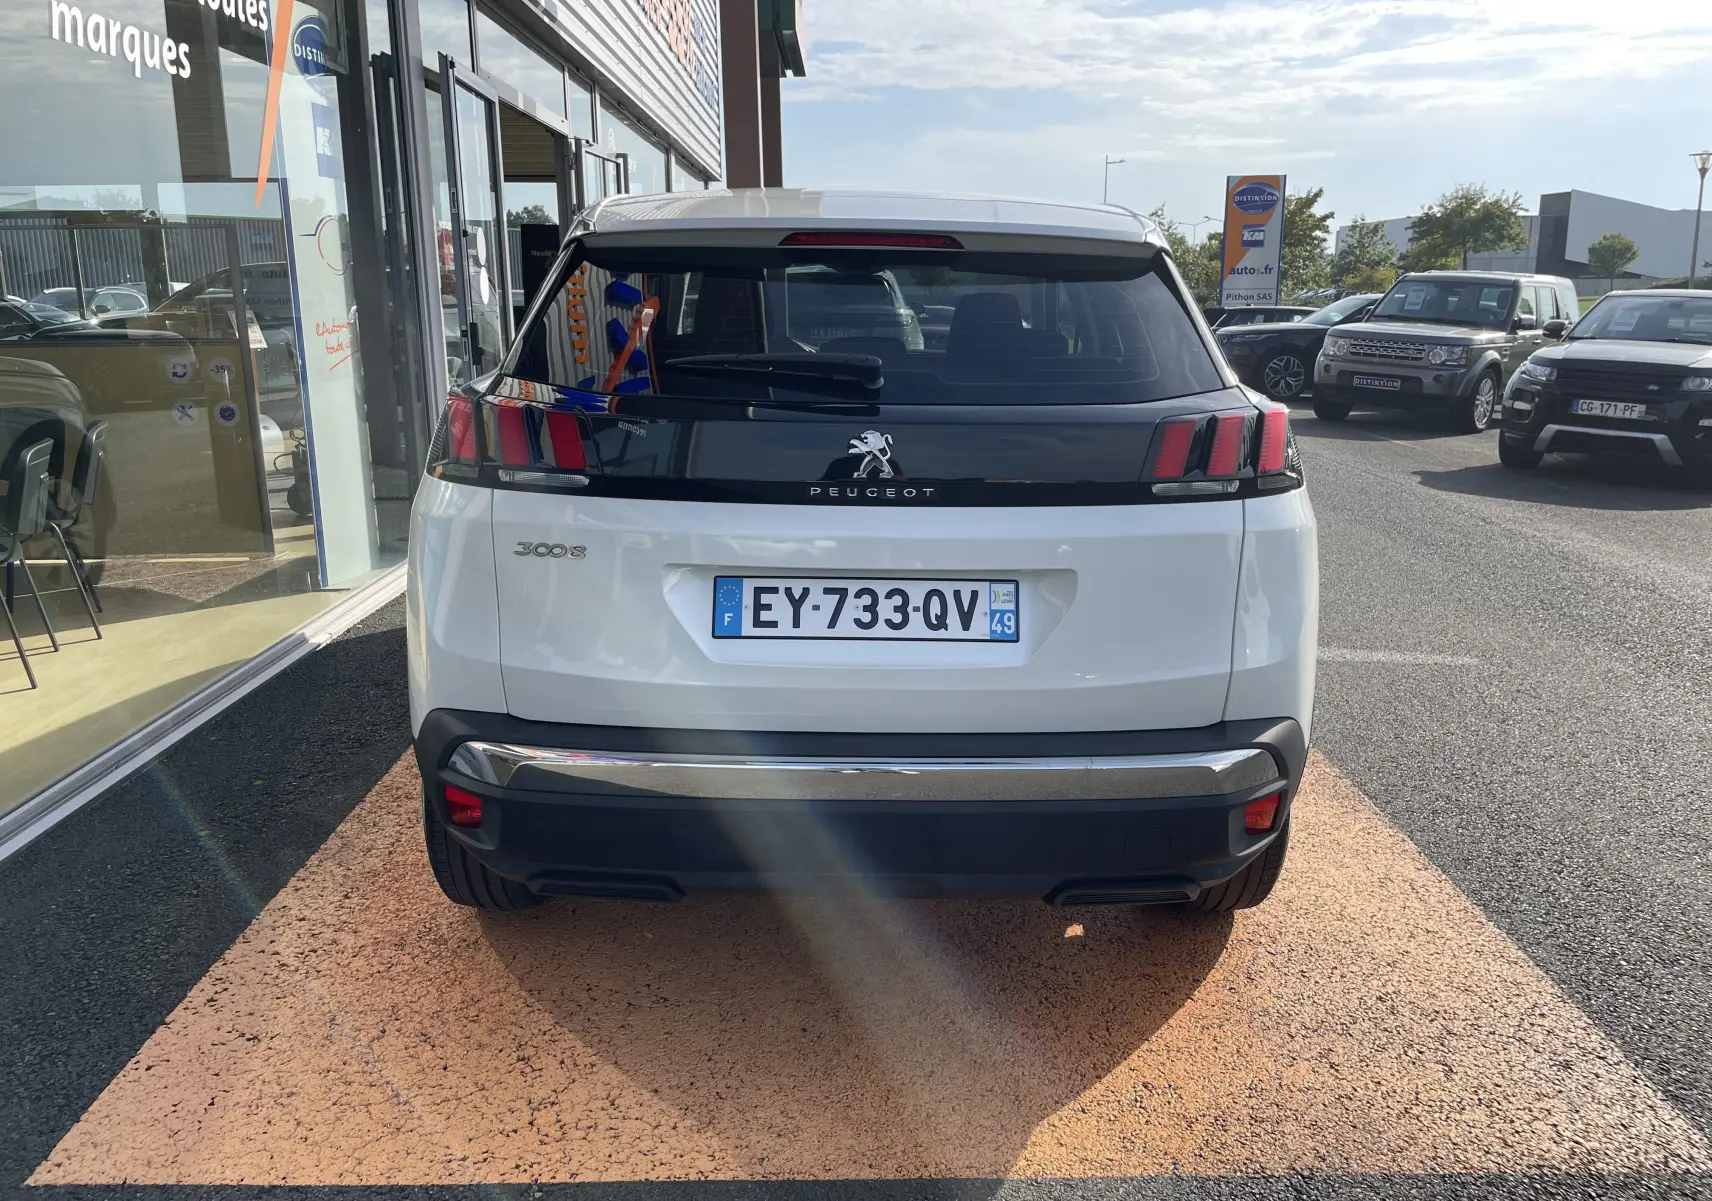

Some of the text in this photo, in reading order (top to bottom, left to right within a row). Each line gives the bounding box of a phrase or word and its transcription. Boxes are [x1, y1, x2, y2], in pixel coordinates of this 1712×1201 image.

[52, 0, 191, 79] marques
[1229, 264, 1273, 275] autos.fr
[1226, 293, 1254, 301] Pithon
[1355, 378, 1398, 388] DISTINXION
[1580, 401, 1638, 416] CG-171-PF
[810, 487, 934, 497] PEUGEOT
[513, 541, 587, 559] 3008
[752, 586, 979, 631] EY-733-QV
[724, 613, 733, 626] F
[991, 612, 1015, 634] 49
